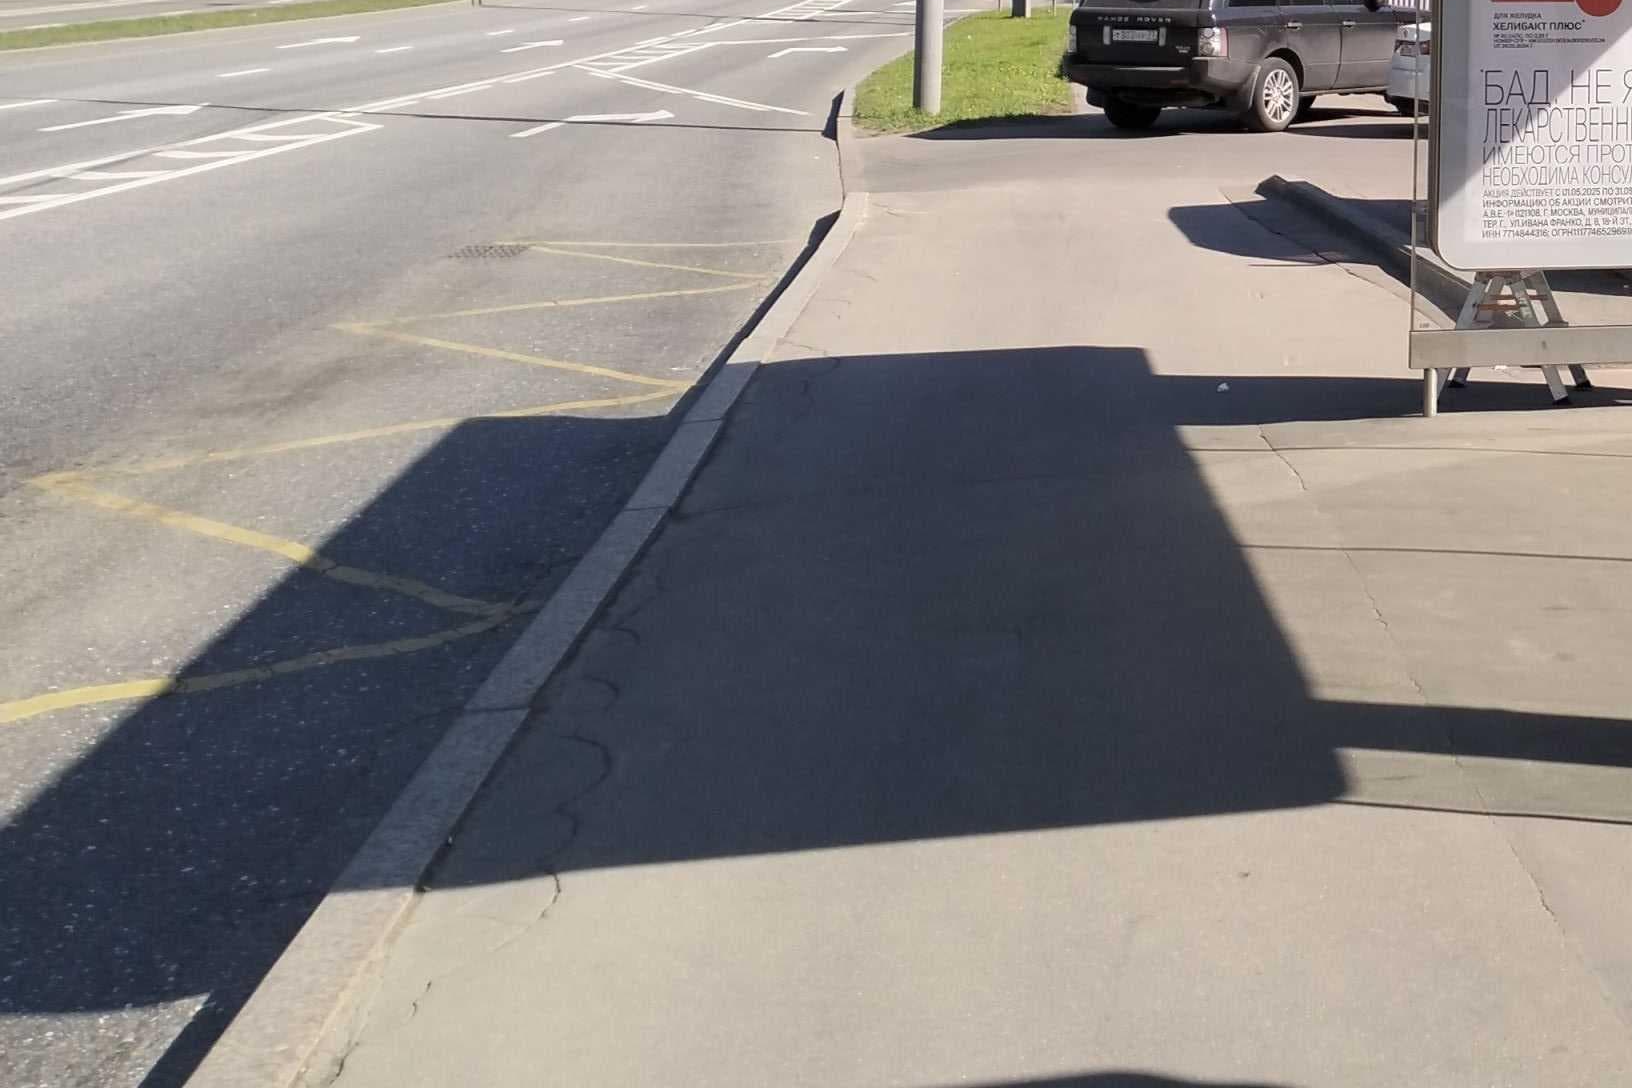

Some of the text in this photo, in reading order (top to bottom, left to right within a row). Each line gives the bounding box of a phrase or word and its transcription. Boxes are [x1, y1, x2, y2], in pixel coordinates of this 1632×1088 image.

[1493, 21, 1546, 31] ХЕЛИБАКТ
[1571, 68, 1613, 105] НЕ
[1482, 144, 1581, 165] ИМЕЮТСЯ
[1482, 165, 1580, 187] НЕОБХОДИМА
